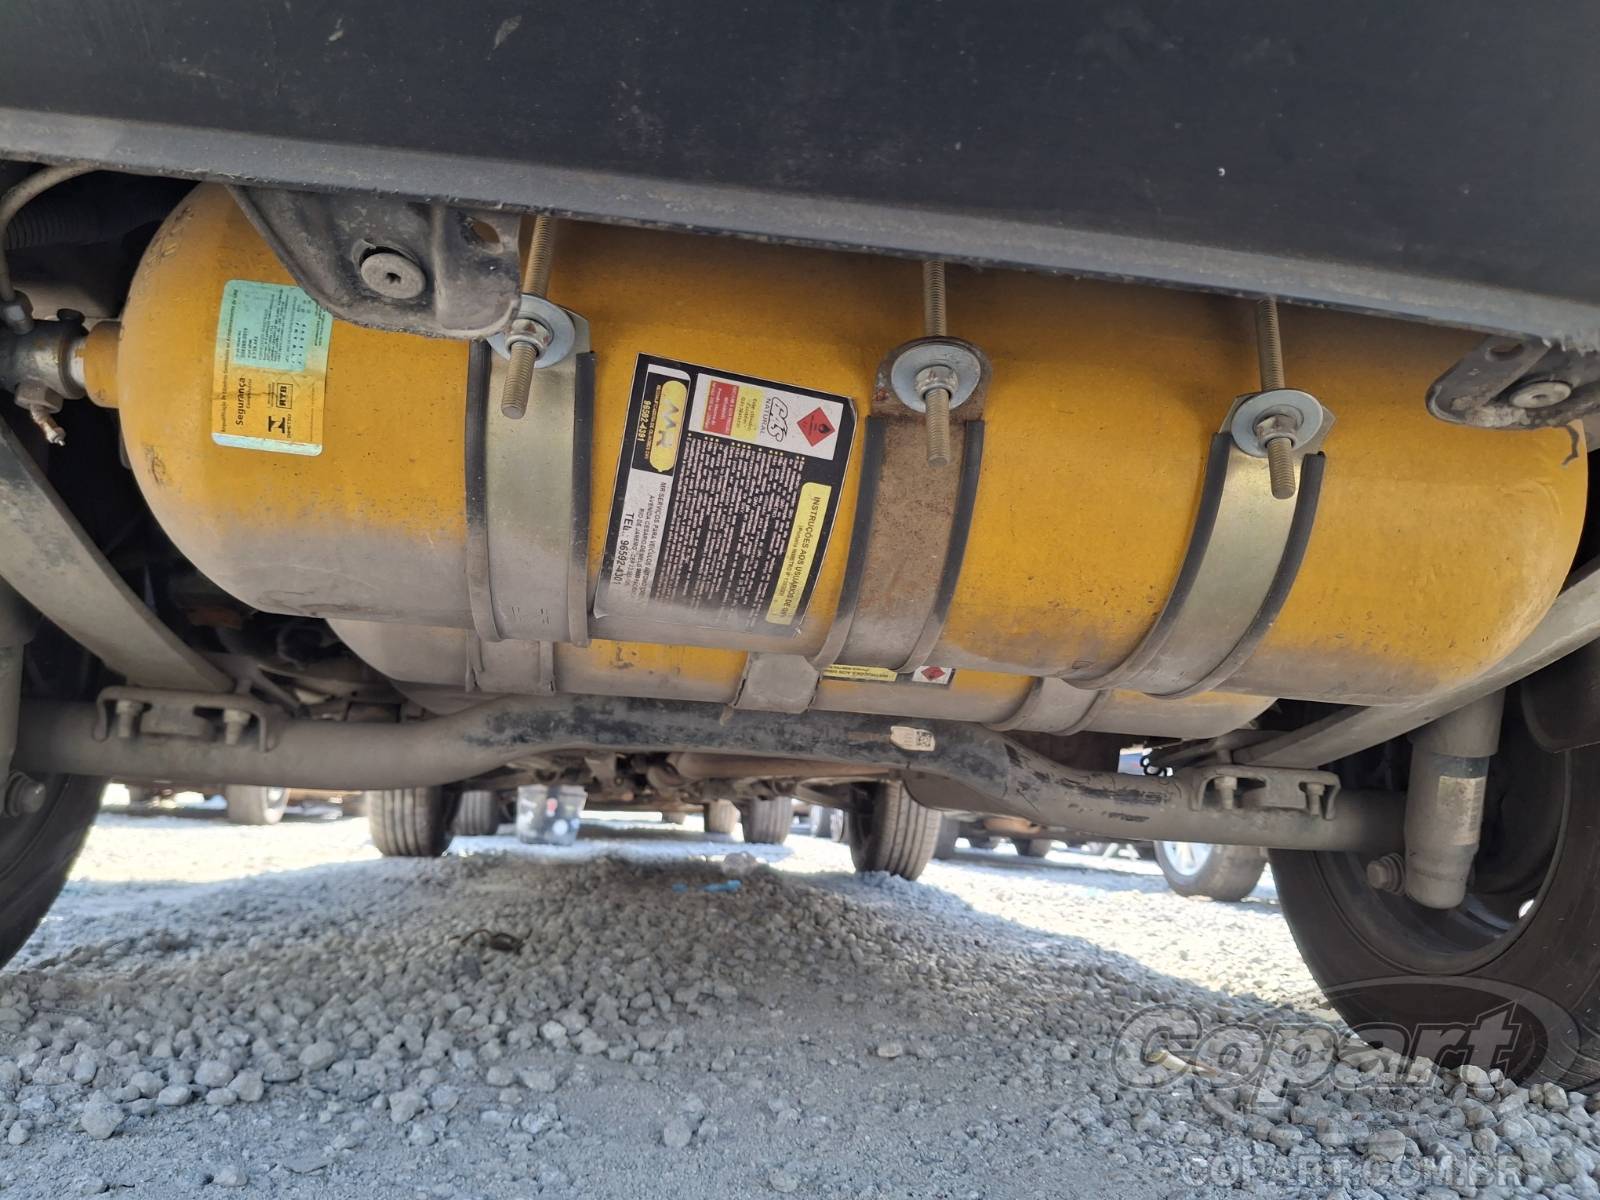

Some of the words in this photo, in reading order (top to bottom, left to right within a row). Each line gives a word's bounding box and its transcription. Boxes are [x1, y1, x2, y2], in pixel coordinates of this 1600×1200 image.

[235, 377, 246, 425] Segurança
[760, 398, 770, 434] NATURAL
[646, 494, 654, 520] AVENIDA
[654, 492, 664, 523] SERVIÇOS
[650, 523, 658, 539] PARA
[797, 548, 805, 565] AOS
